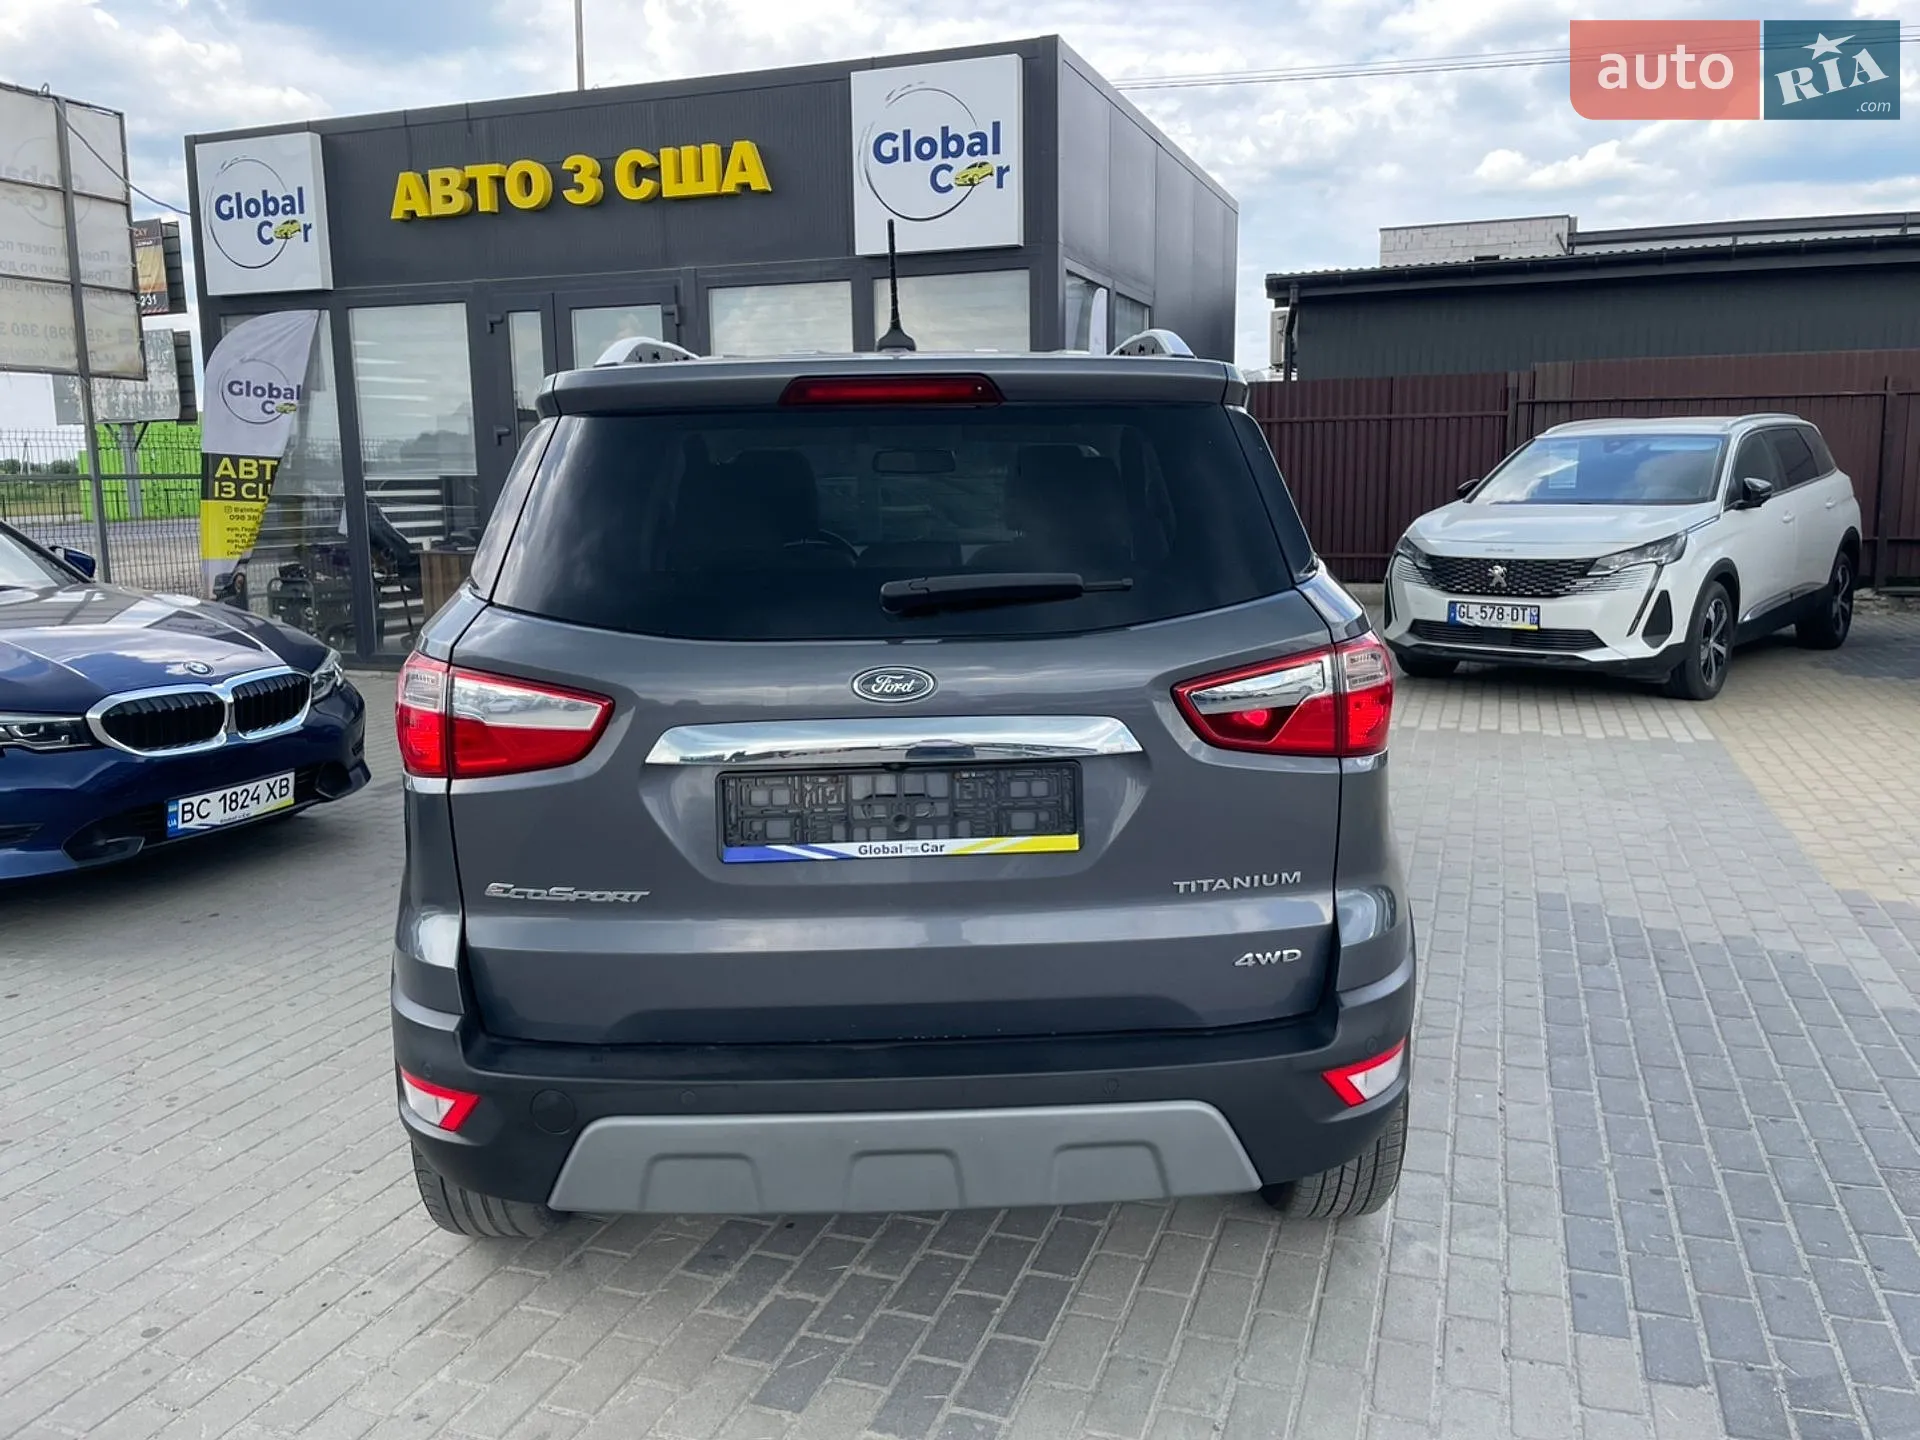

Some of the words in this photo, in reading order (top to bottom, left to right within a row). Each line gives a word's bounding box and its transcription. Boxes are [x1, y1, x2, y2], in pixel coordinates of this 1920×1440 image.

[873, 121, 1001, 164] Global
[390, 159, 553, 221] АВТО
[614, 140, 772, 200] США
[215, 186, 305, 221] Global
[227, 380, 301, 401] Global
[214, 457, 278, 480] АВТ
[871, 675, 915, 693] Ford
[181, 798, 212, 824] BC
[218, 784, 261, 814] 1824
[266, 777, 290, 803] XB
[858, 844, 903, 856] Global
[921, 842, 945, 854] Car
[1173, 871, 1301, 894] TITANIUM
[1234, 949, 1302, 967] 4WD
